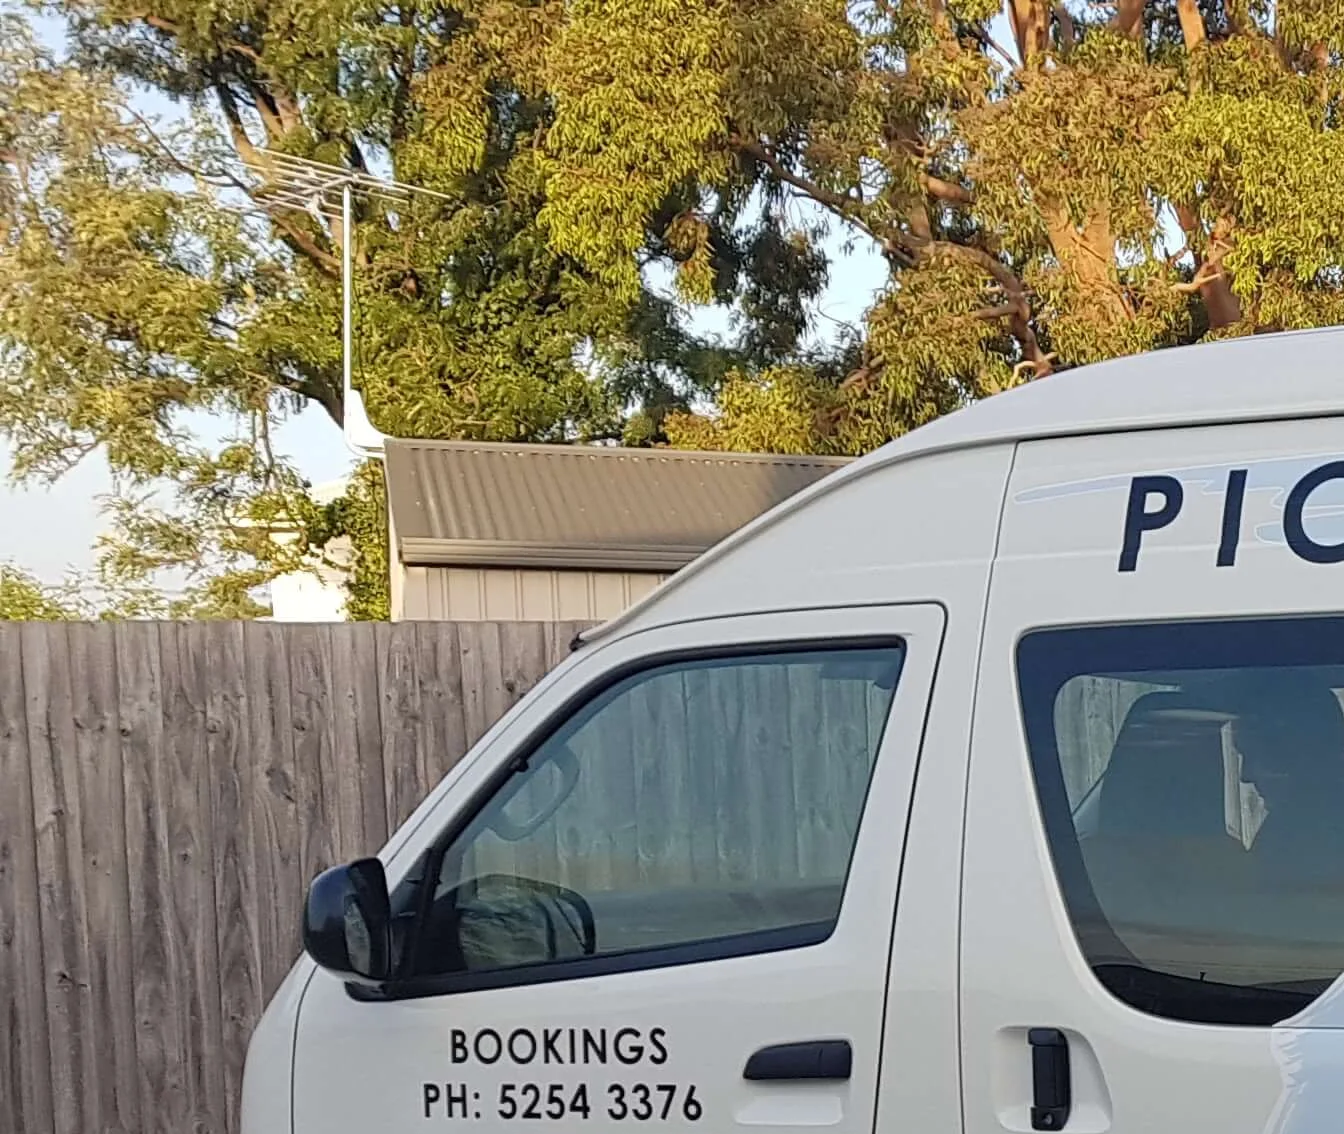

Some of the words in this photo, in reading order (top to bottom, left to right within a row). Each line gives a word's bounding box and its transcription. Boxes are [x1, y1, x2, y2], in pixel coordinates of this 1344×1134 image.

[452, 1028, 667, 1064] BOOKINGS
[424, 1084, 480, 1118] PH:
[499, 1084, 590, 1119] 5254
[608, 1084, 701, 1120] 3376
